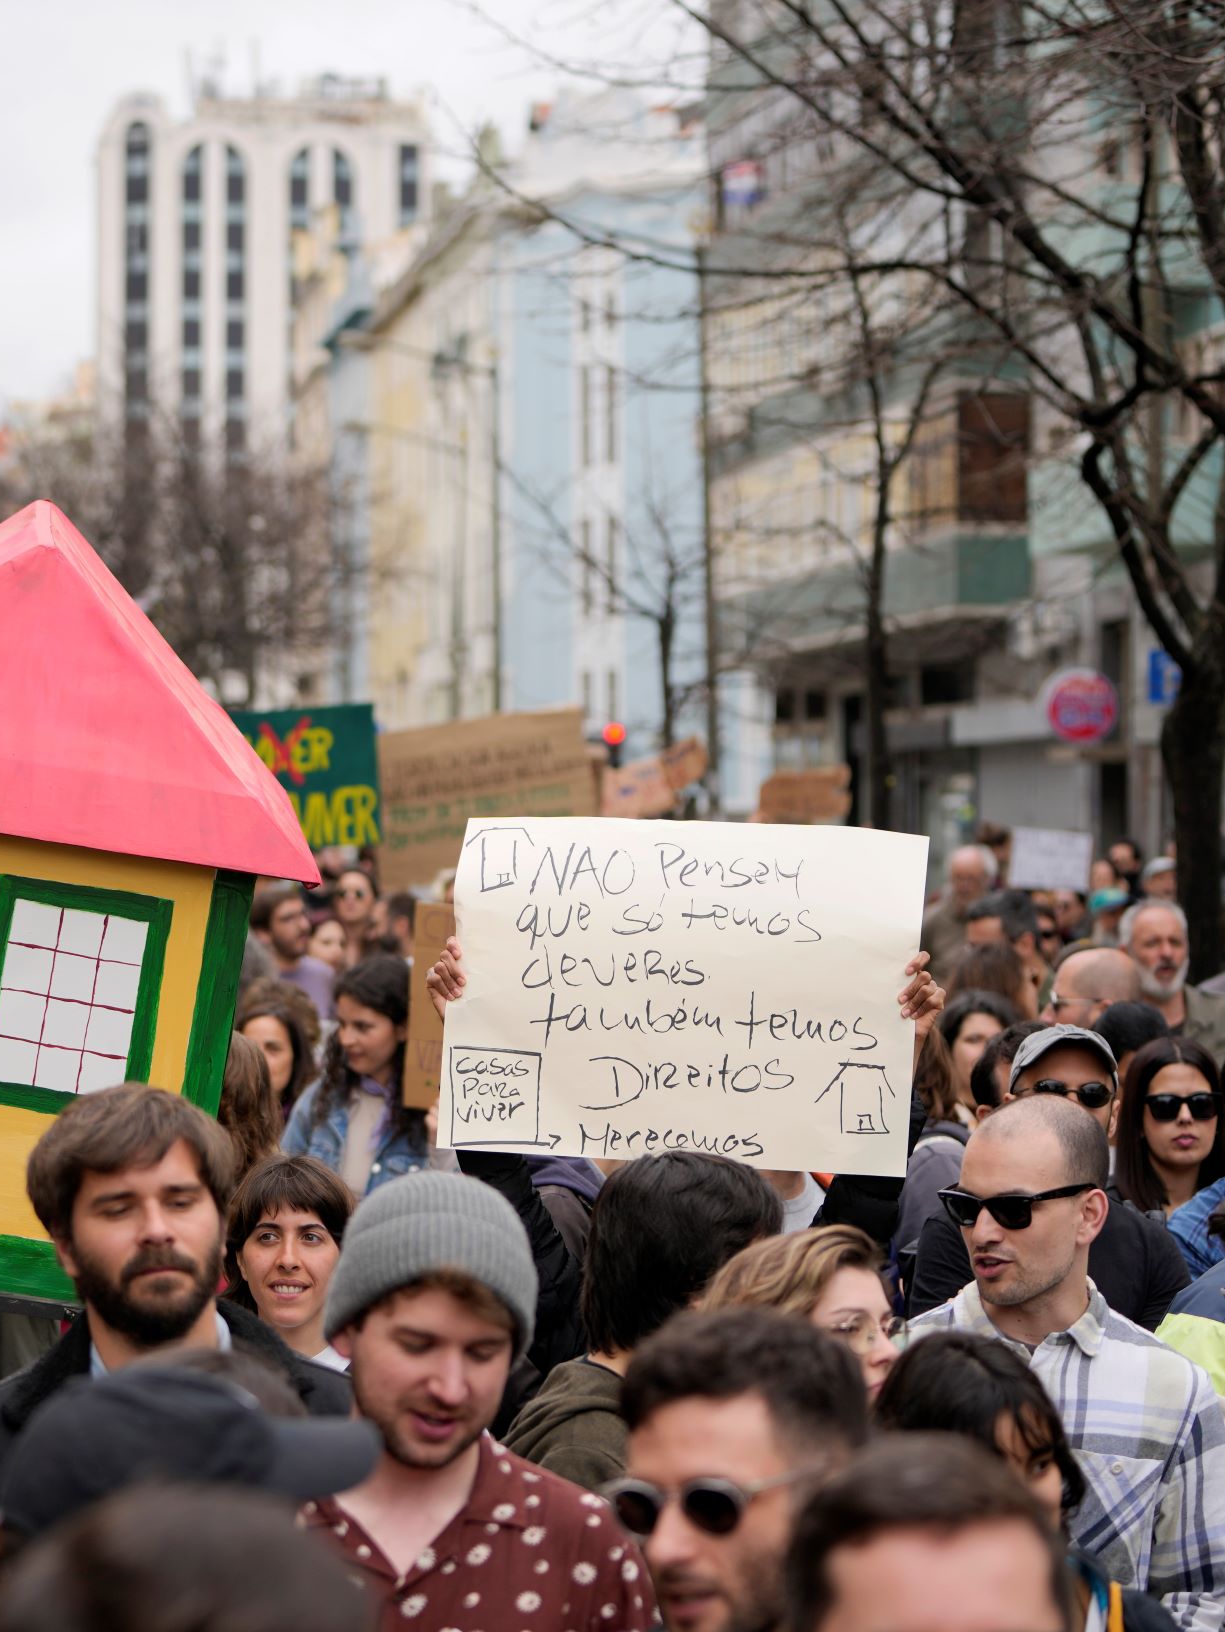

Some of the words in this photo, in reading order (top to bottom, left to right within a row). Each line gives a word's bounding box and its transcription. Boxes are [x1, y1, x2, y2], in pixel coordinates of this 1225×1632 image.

[516, 901, 591, 950] que
[612, 892, 664, 935] só
[681, 898, 822, 942] temos
[530, 992, 724, 1049] também
[734, 990, 878, 1050] temos
